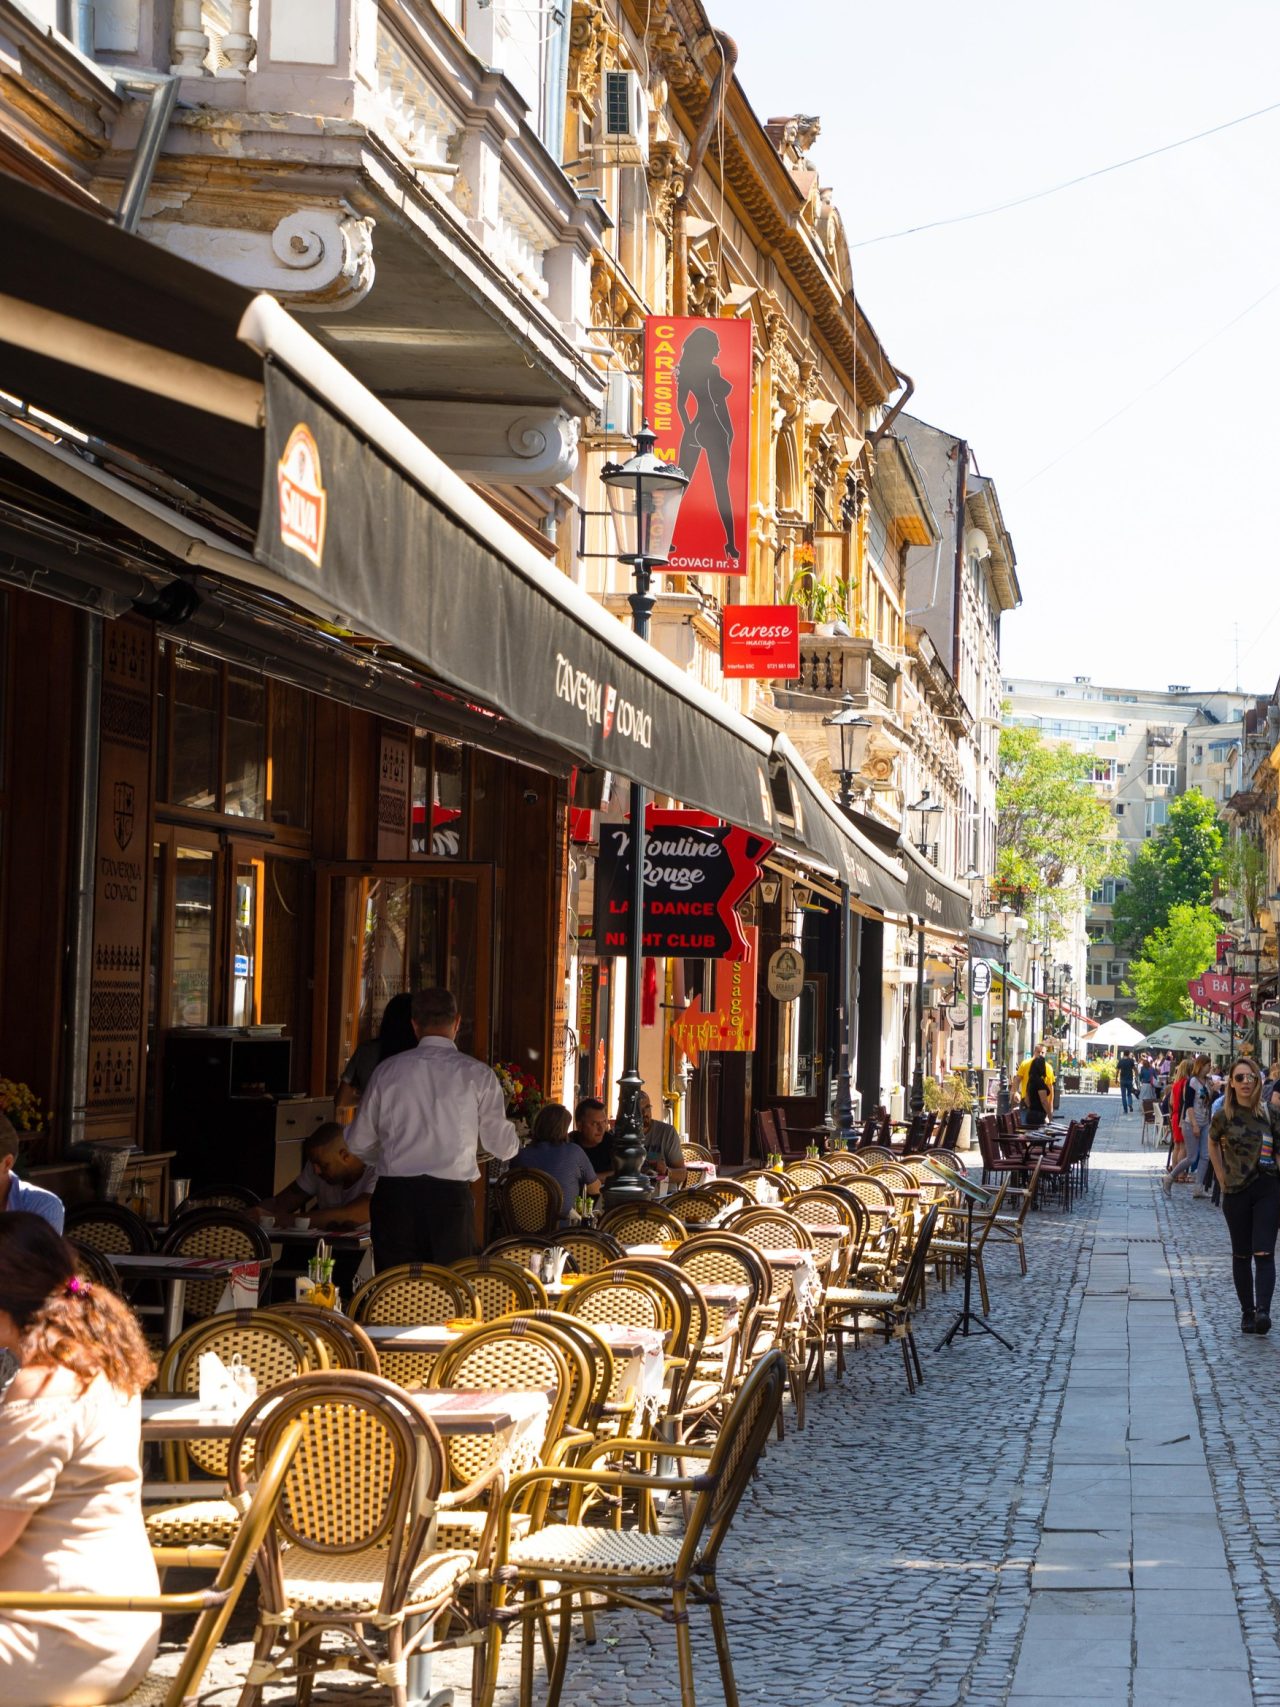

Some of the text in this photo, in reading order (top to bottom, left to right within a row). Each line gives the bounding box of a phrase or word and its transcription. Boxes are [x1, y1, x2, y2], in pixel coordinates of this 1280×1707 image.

[654, 325, 675, 431] CARESSE
[716, 559, 730, 568] nr.
[733, 559, 740, 568] 3
[729, 623, 793, 638] Caresse
[556, 653, 652, 749] TAVERNA COVACI
[651, 901, 715, 915] DANCE
[605, 932, 716, 948] NIHT CLUB
[679, 1024, 719, 1039] FIRE
